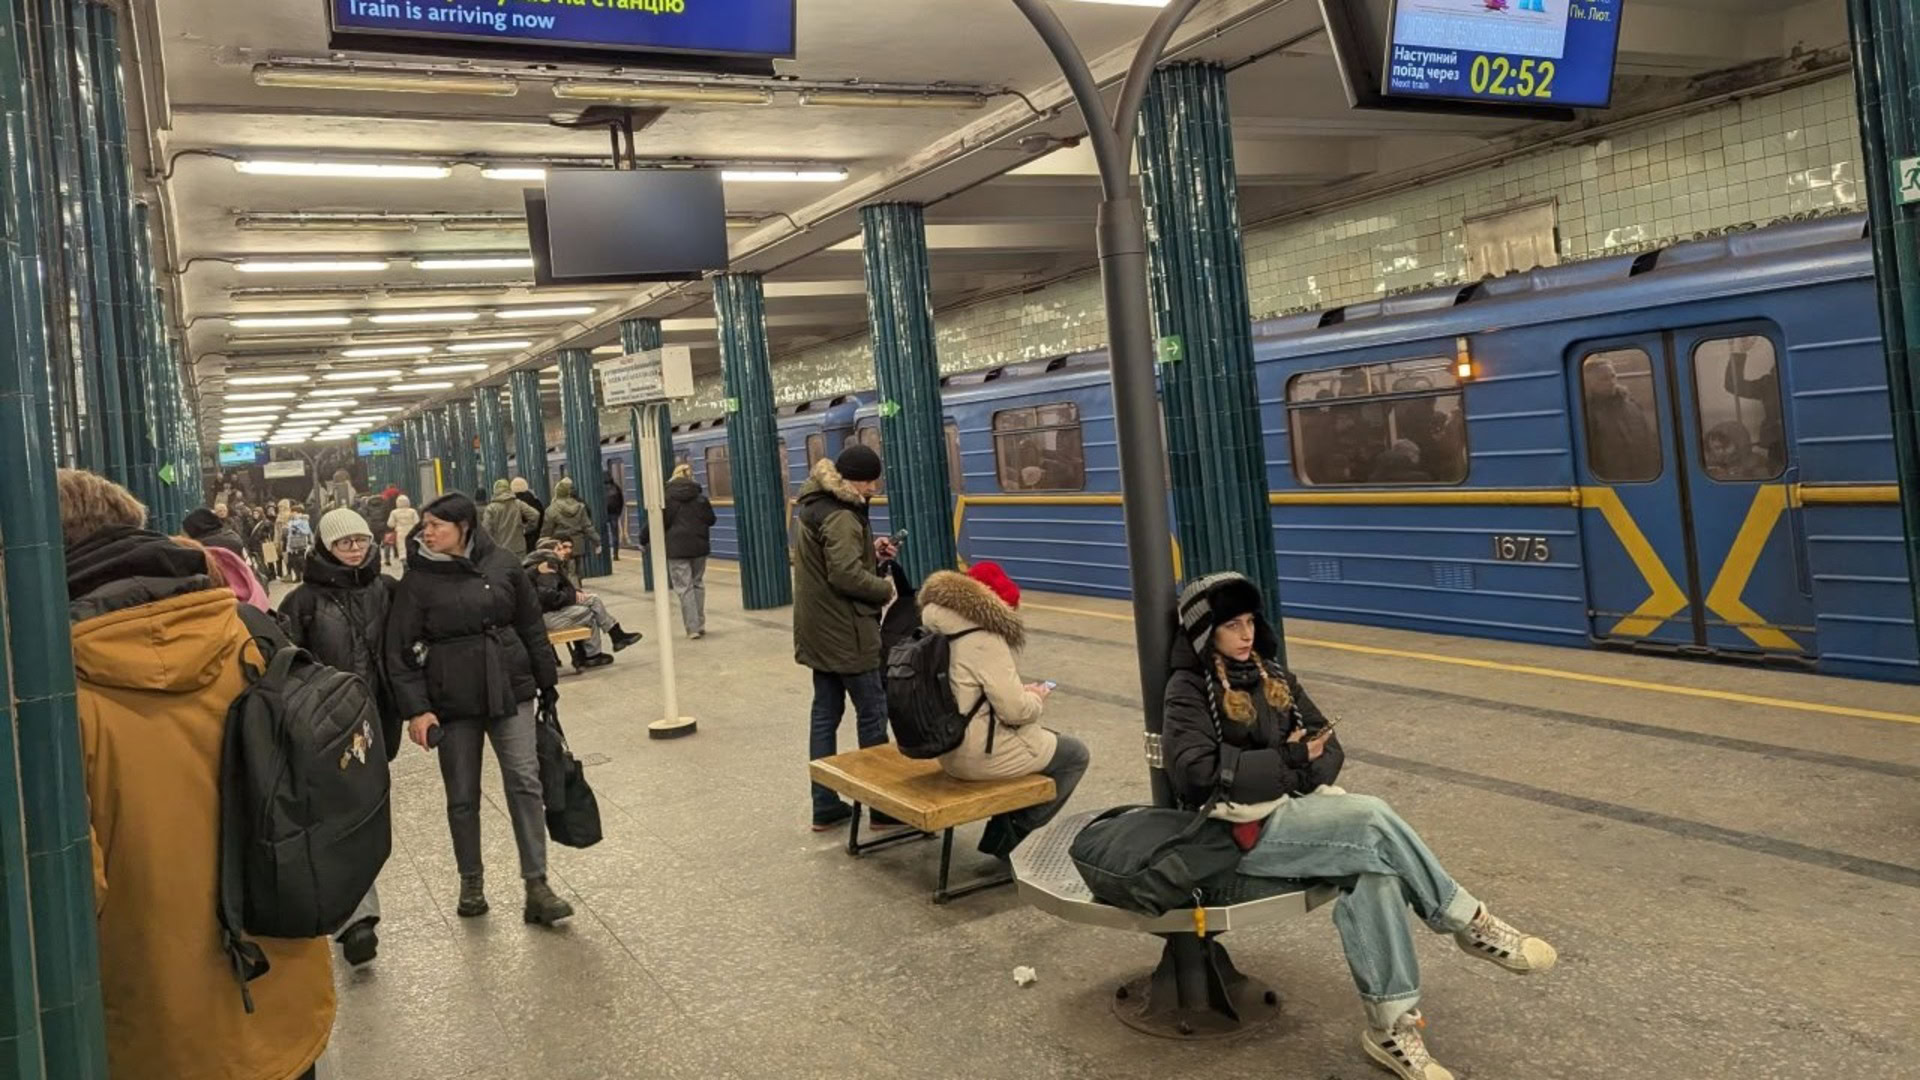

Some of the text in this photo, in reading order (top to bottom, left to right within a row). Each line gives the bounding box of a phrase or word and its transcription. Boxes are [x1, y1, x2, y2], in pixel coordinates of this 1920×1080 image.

[350, 0, 556, 31] Train is arriving now
[1394, 46, 1458, 66] Наступний
[1393, 63, 1460, 84] поїзд через
[1470, 55, 1555, 97] 02:52
[1494, 536, 1549, 561] 1675
